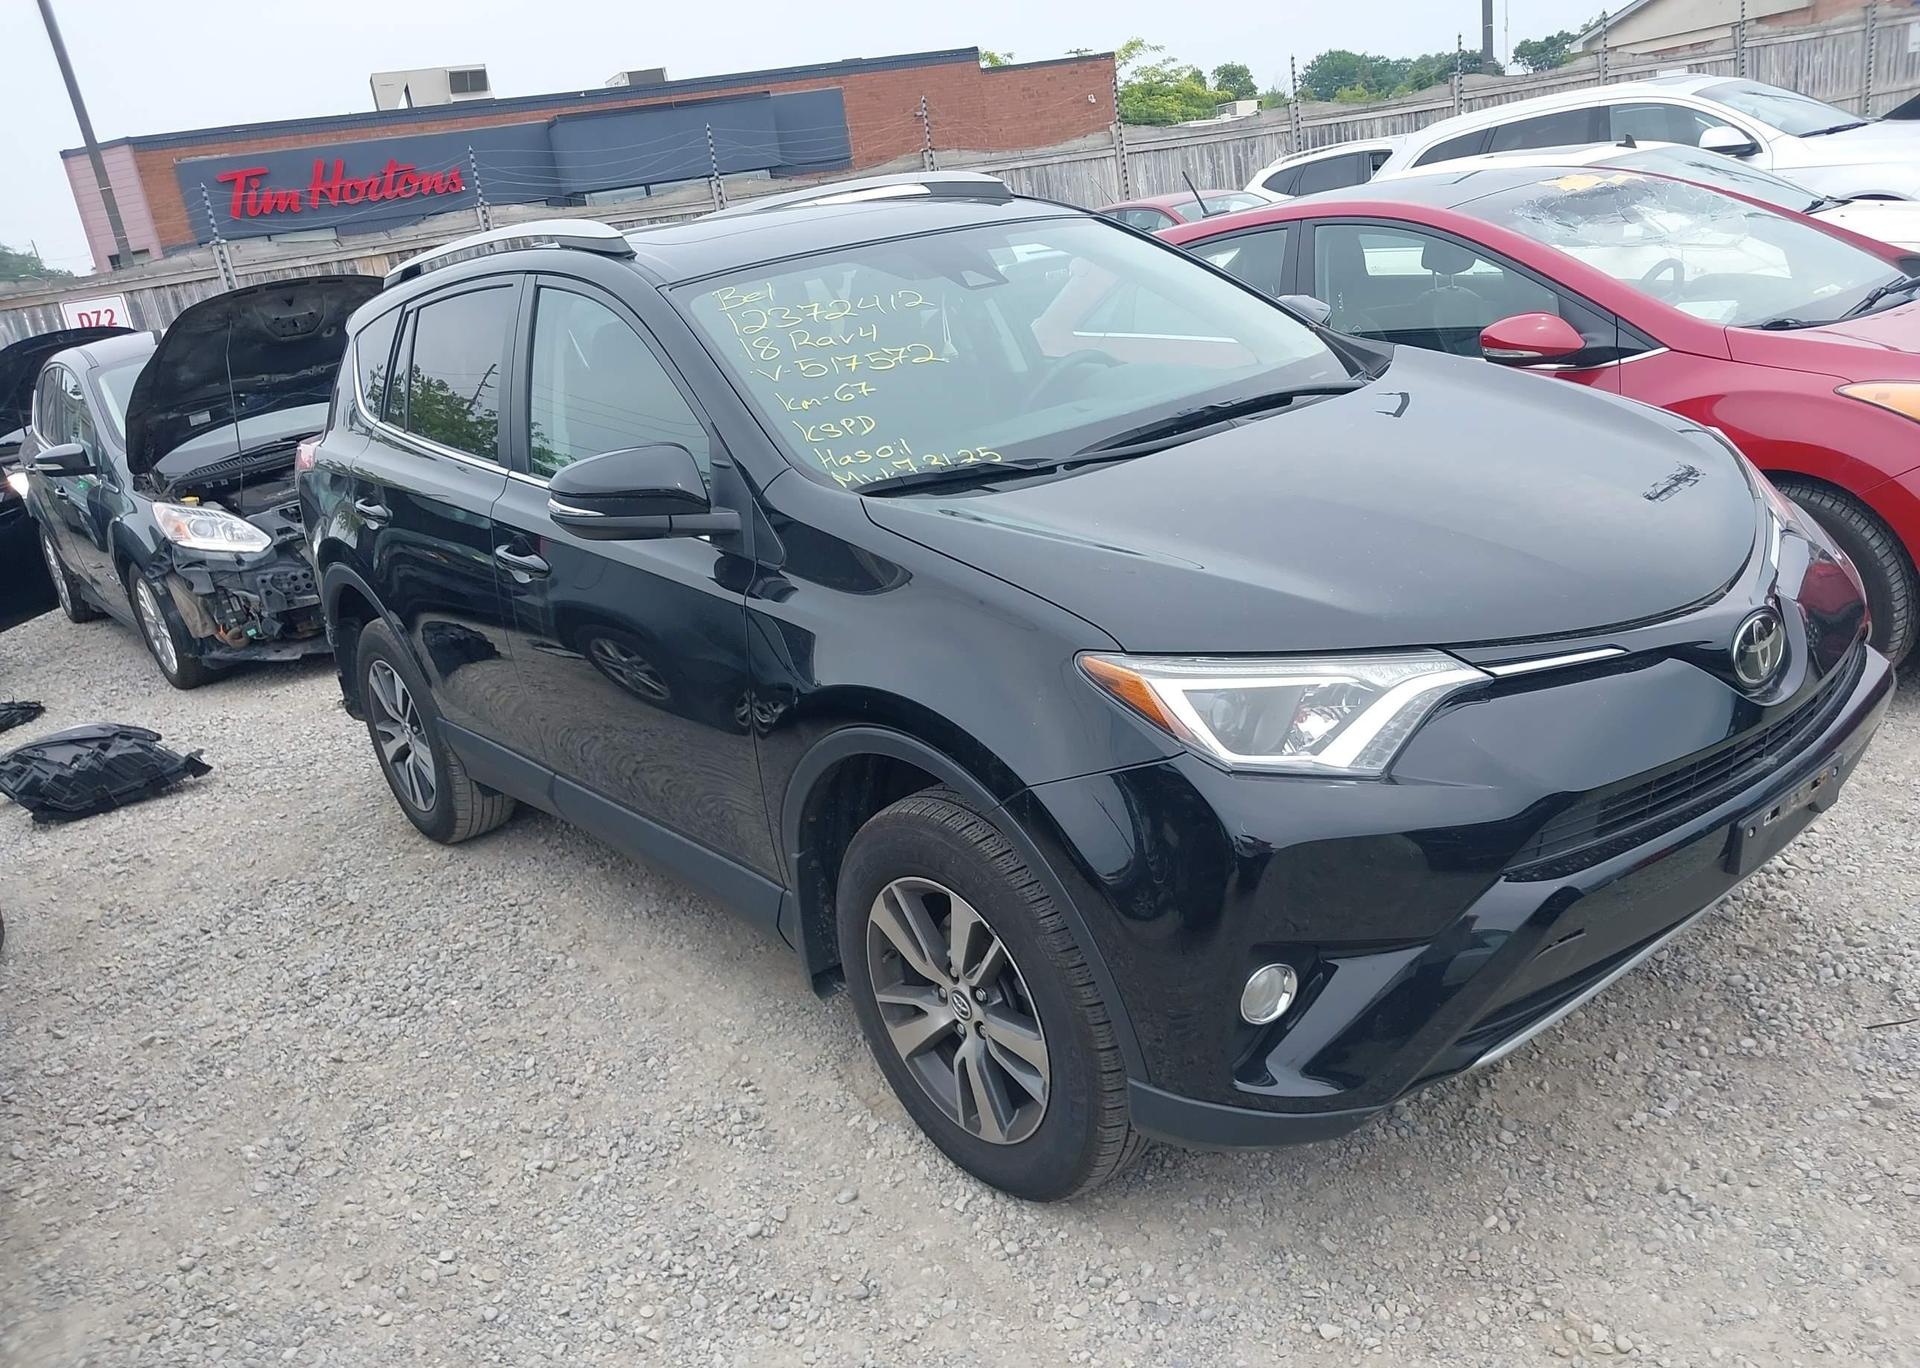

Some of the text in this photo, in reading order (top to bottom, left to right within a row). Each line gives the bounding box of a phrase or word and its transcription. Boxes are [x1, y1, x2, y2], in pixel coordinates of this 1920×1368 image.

[216, 159, 465, 220] Tim Hortons
[712, 282, 775, 311] Bel
[727, 290, 935, 336] 12372412
[77, 308, 118, 328] DZ2
[739, 324, 877, 361] 18 Rav4
